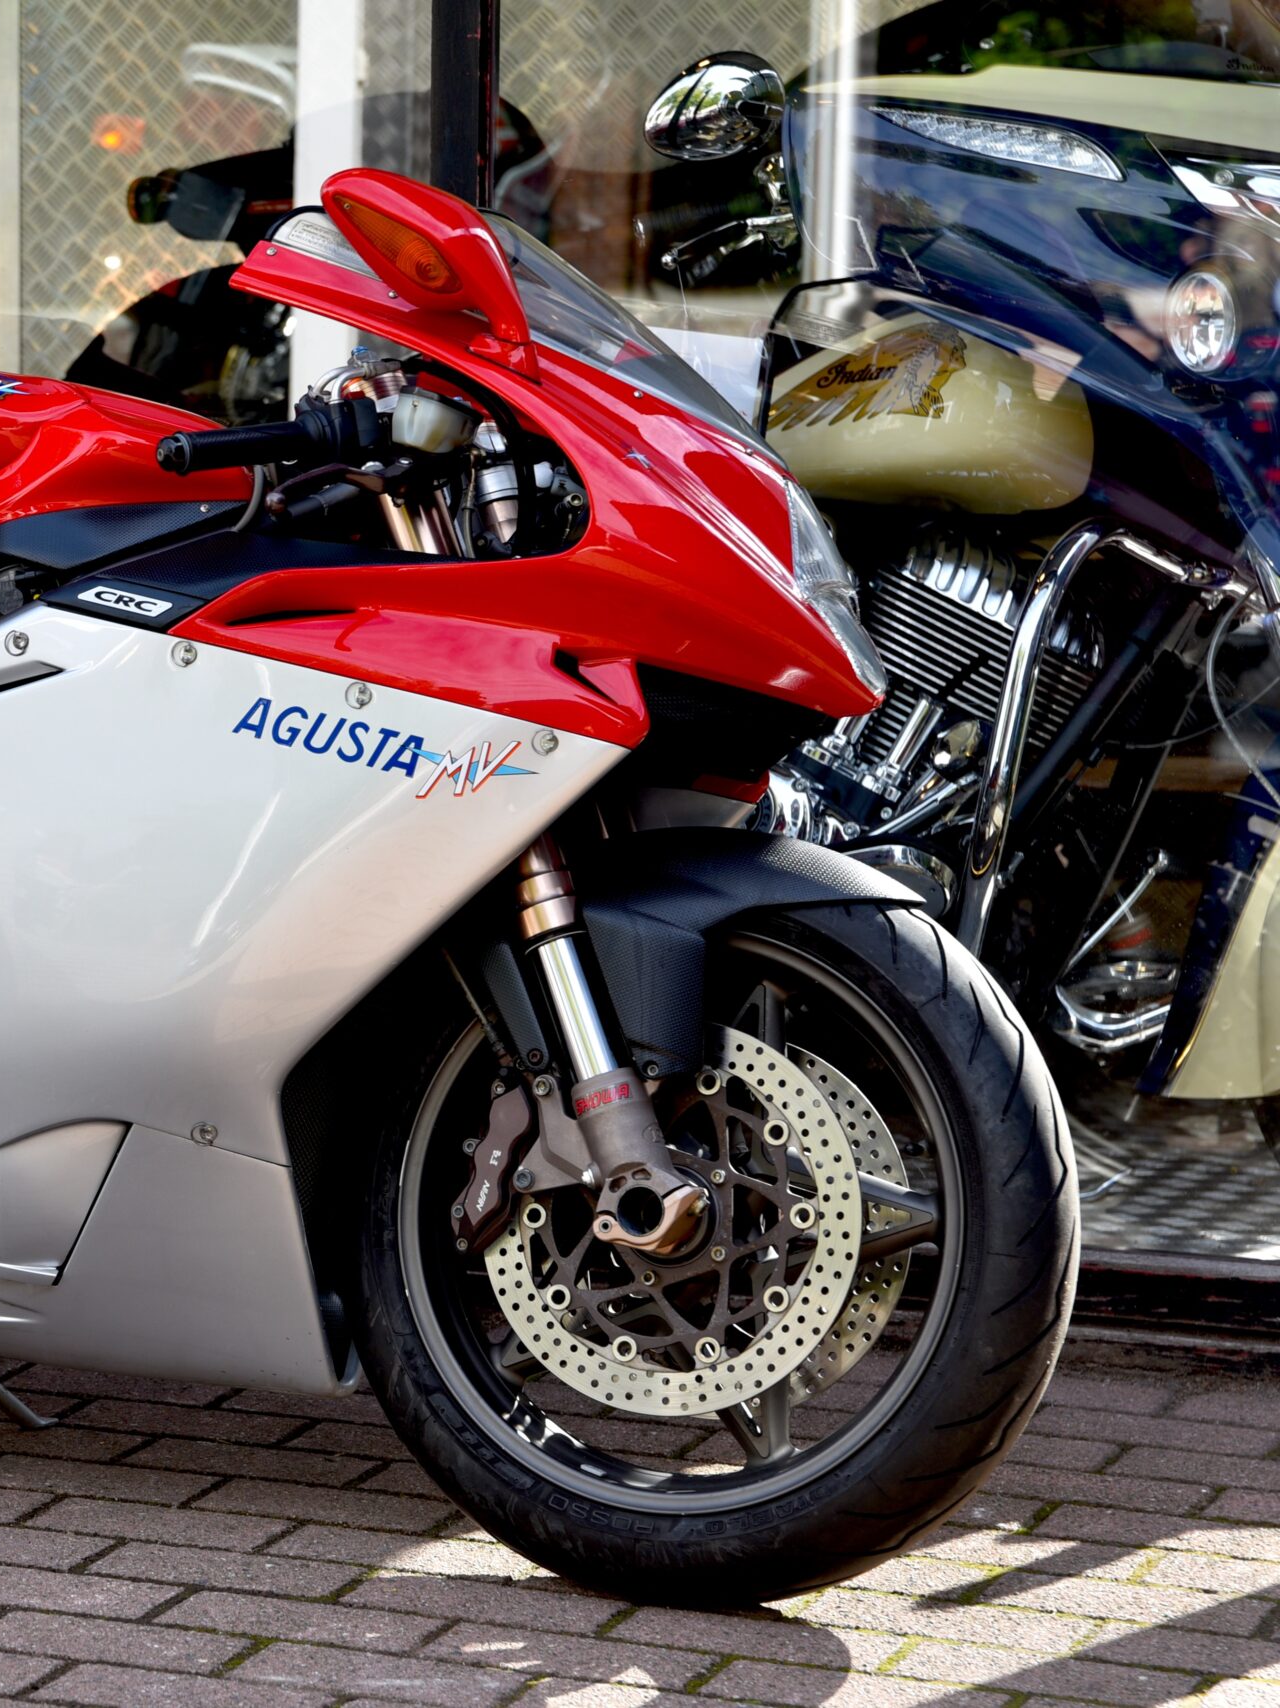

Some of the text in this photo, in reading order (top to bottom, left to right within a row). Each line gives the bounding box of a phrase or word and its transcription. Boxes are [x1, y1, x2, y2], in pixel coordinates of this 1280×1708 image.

[817, 361, 899, 388] Indian
[94, 590, 158, 612] CRC
[232, 697, 522, 799] AGUSTA MV
[574, 1082, 631, 1117] SHOWA
[548, 1492, 656, 1536] ROSSO
